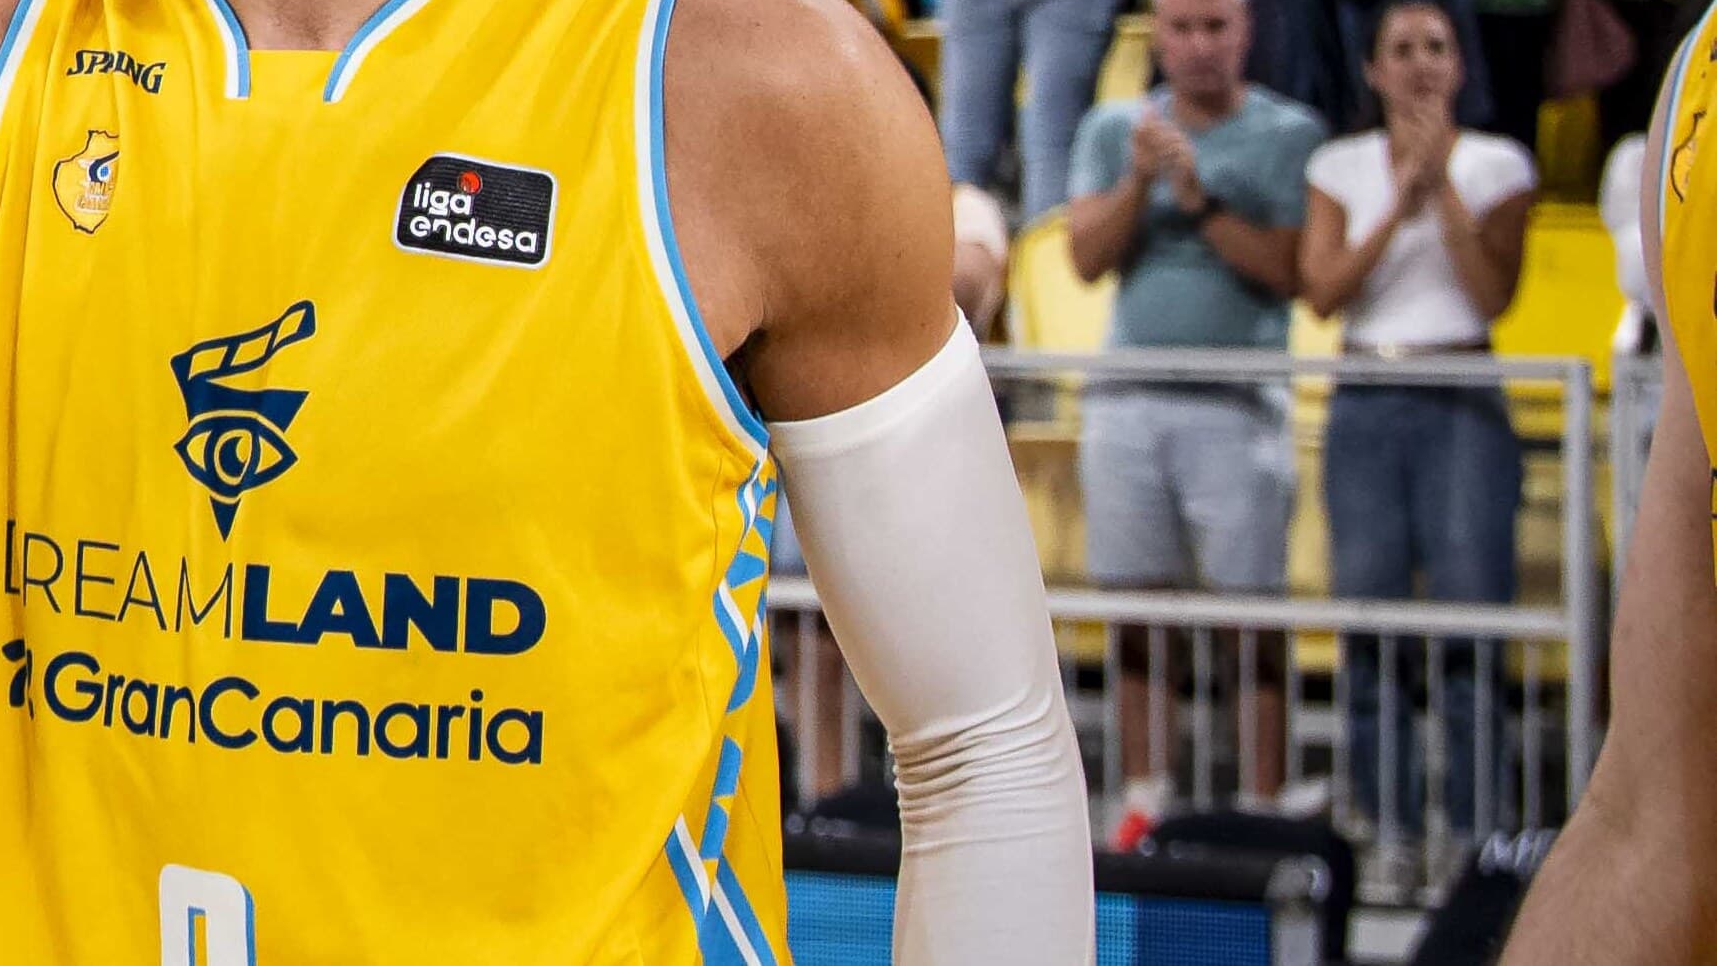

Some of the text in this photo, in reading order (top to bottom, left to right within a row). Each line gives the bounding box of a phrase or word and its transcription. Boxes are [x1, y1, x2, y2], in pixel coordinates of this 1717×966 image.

[413, 182, 473, 216] liga
[410, 215, 539, 254] endesa
[43, 650, 545, 766] GranCanaria
